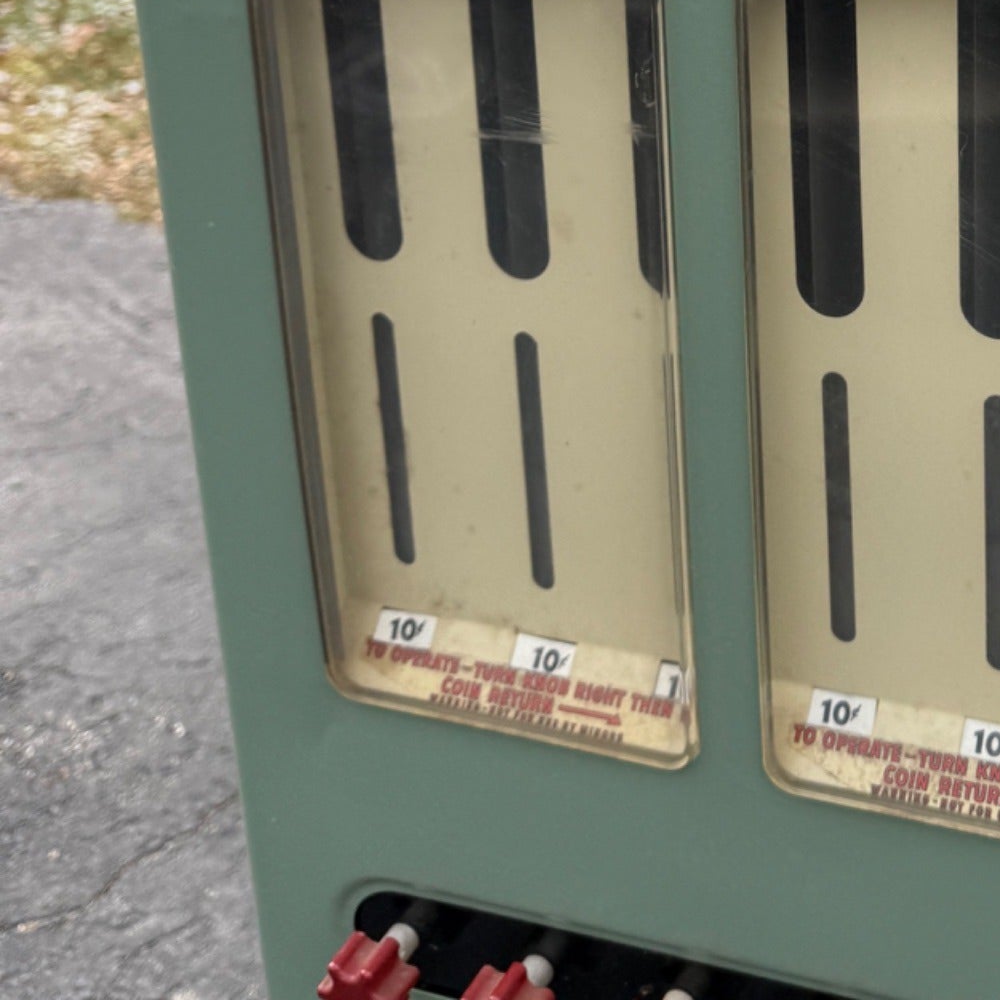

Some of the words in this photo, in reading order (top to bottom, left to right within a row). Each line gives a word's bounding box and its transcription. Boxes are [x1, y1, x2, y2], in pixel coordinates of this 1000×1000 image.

[440, 675, 481, 700] COIN
[793, 723, 817, 746] TO
[883, 764, 930, 791] COIN
